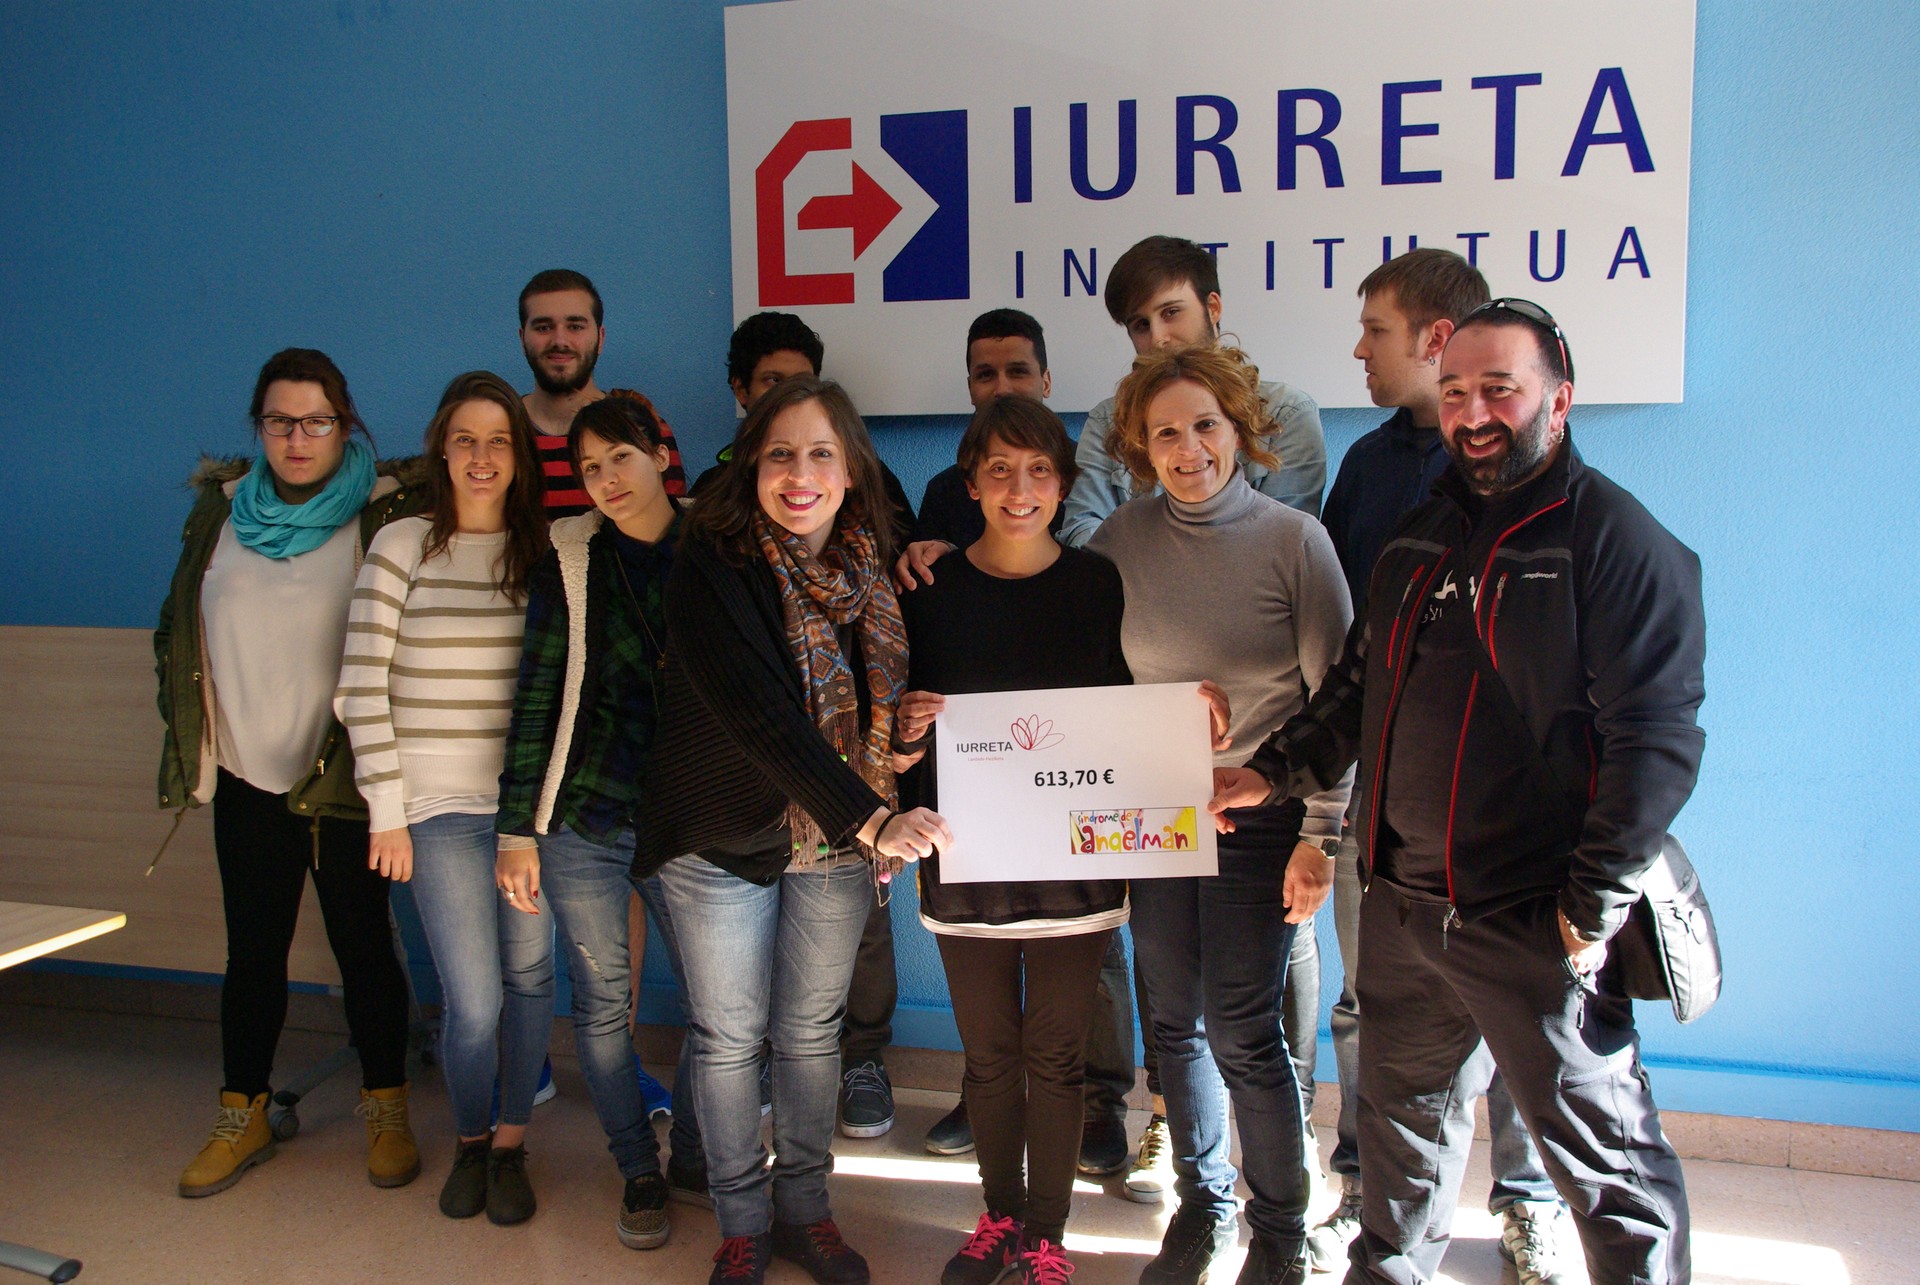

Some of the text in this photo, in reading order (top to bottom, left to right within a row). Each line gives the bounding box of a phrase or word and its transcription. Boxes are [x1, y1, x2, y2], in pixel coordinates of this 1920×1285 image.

[1014, 67, 1656, 203] IURRETA
[956, 741, 1013, 753] IURRETA
[1034, 769, 1114, 788] 613,70 €
[1120, 809, 1132, 821] de
[1080, 817, 1188, 854] angelman
